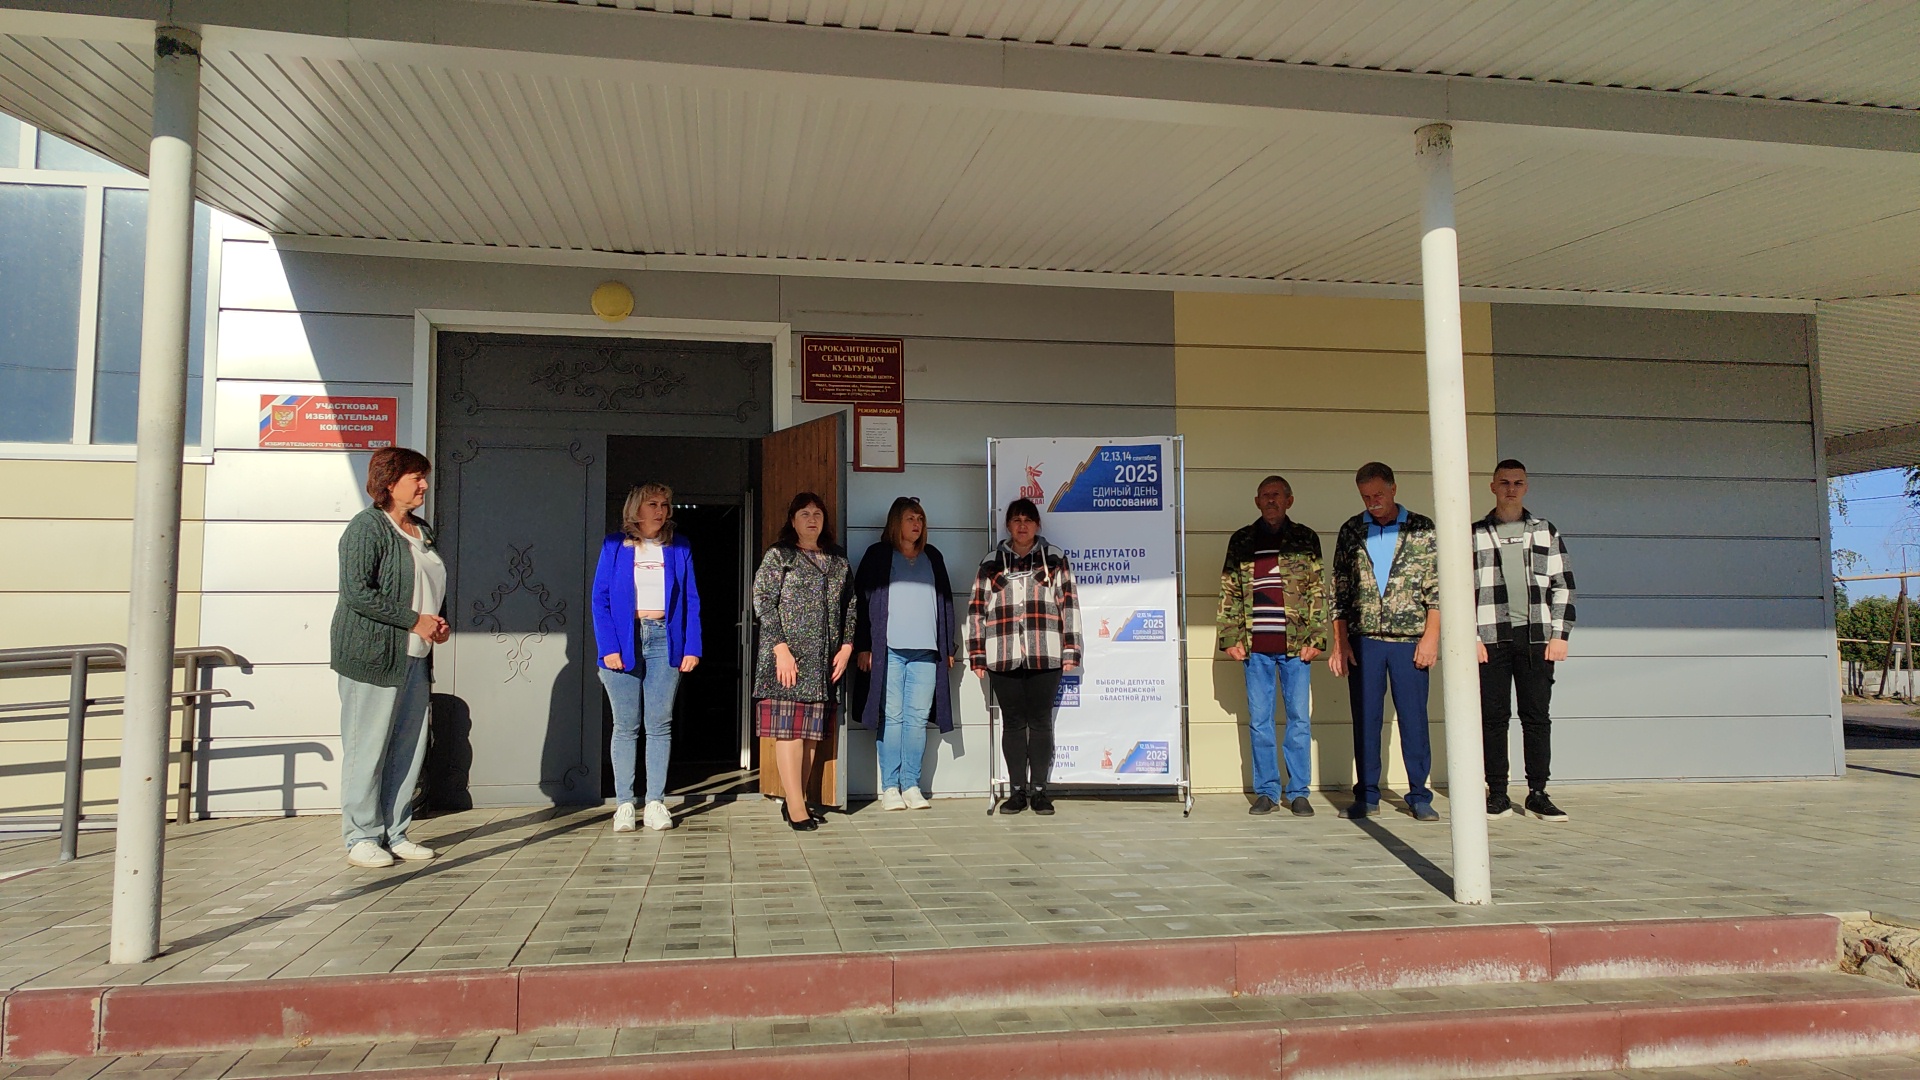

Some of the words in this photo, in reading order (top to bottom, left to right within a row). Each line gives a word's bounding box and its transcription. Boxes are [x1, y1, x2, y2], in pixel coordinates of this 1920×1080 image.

[807, 344, 898, 354] СТАРОКАЛИТВЕНСКИЙ
[821, 354, 865, 363] СЕЛЬСКИЙ
[865, 356, 884, 364] ДОМ
[832, 364, 874, 372] КУЛЬТУРЫ
[315, 402, 379, 411] УЧАСТКОВАЯ
[305, 412, 388, 422] ИЗБИРАТЕЛЬНАЯ
[319, 424, 374, 432] КОМИССИЯ
[1100, 451, 1131, 462] 12,13,14
[1114, 464, 1158, 483] 2025
[1020, 485, 1033, 499] 80
[1092, 485, 1131, 498] ЕДИНЫЙ
[1133, 486, 1158, 498] ДЕНЬ
[1083, 548, 1146, 560] ДЕПУТАТОВ
[1106, 574, 1140, 585] ДУМЫ
[1143, 619, 1164, 628] 2025
[1057, 684, 1078, 694] 2025
[1146, 750, 1167, 760] 2025
